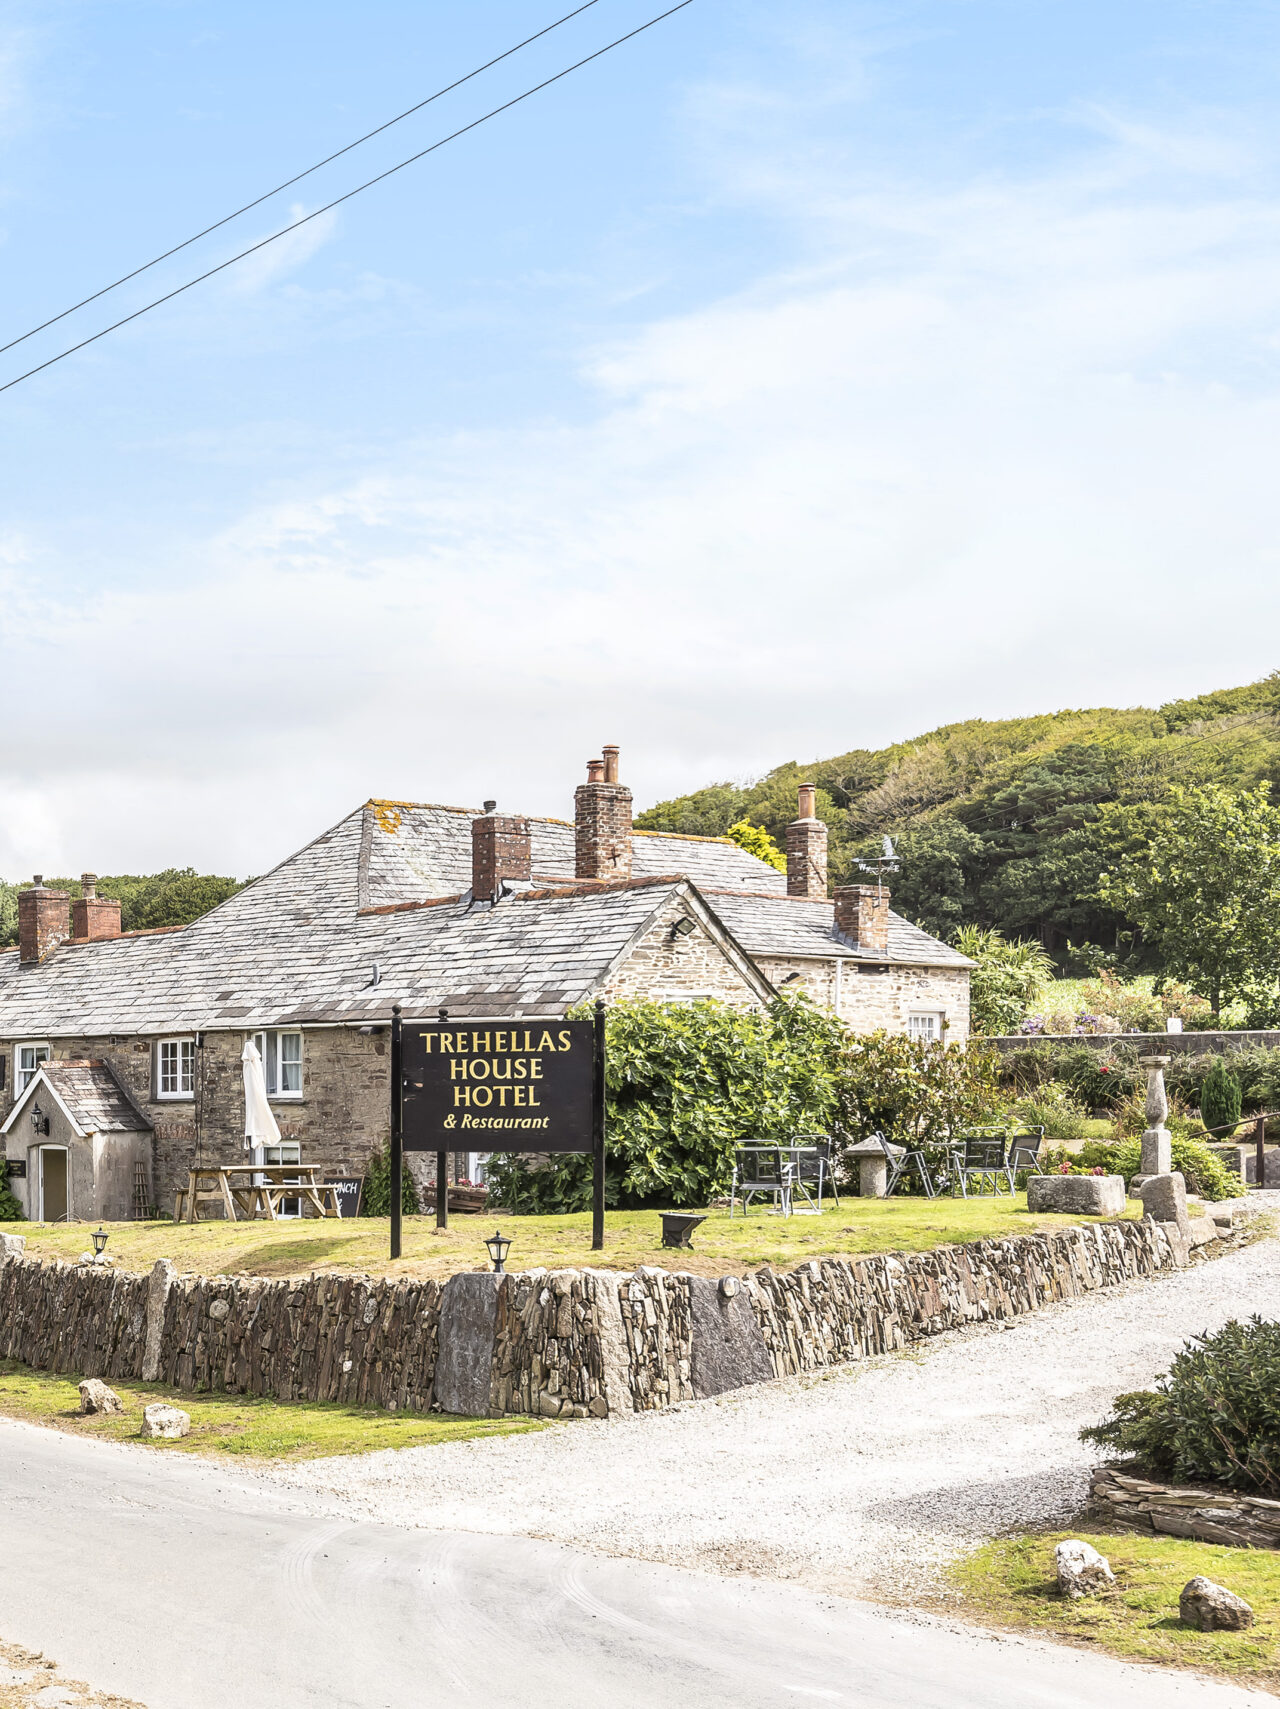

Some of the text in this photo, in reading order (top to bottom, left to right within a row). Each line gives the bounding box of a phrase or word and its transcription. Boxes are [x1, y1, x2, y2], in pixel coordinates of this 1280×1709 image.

[419, 1030, 572, 1053] TREHELLAS
[450, 1058, 544, 1080] HOUSE
[453, 1085, 541, 1107] HOTEL
[443, 1113, 550, 1129] & Restaurant
